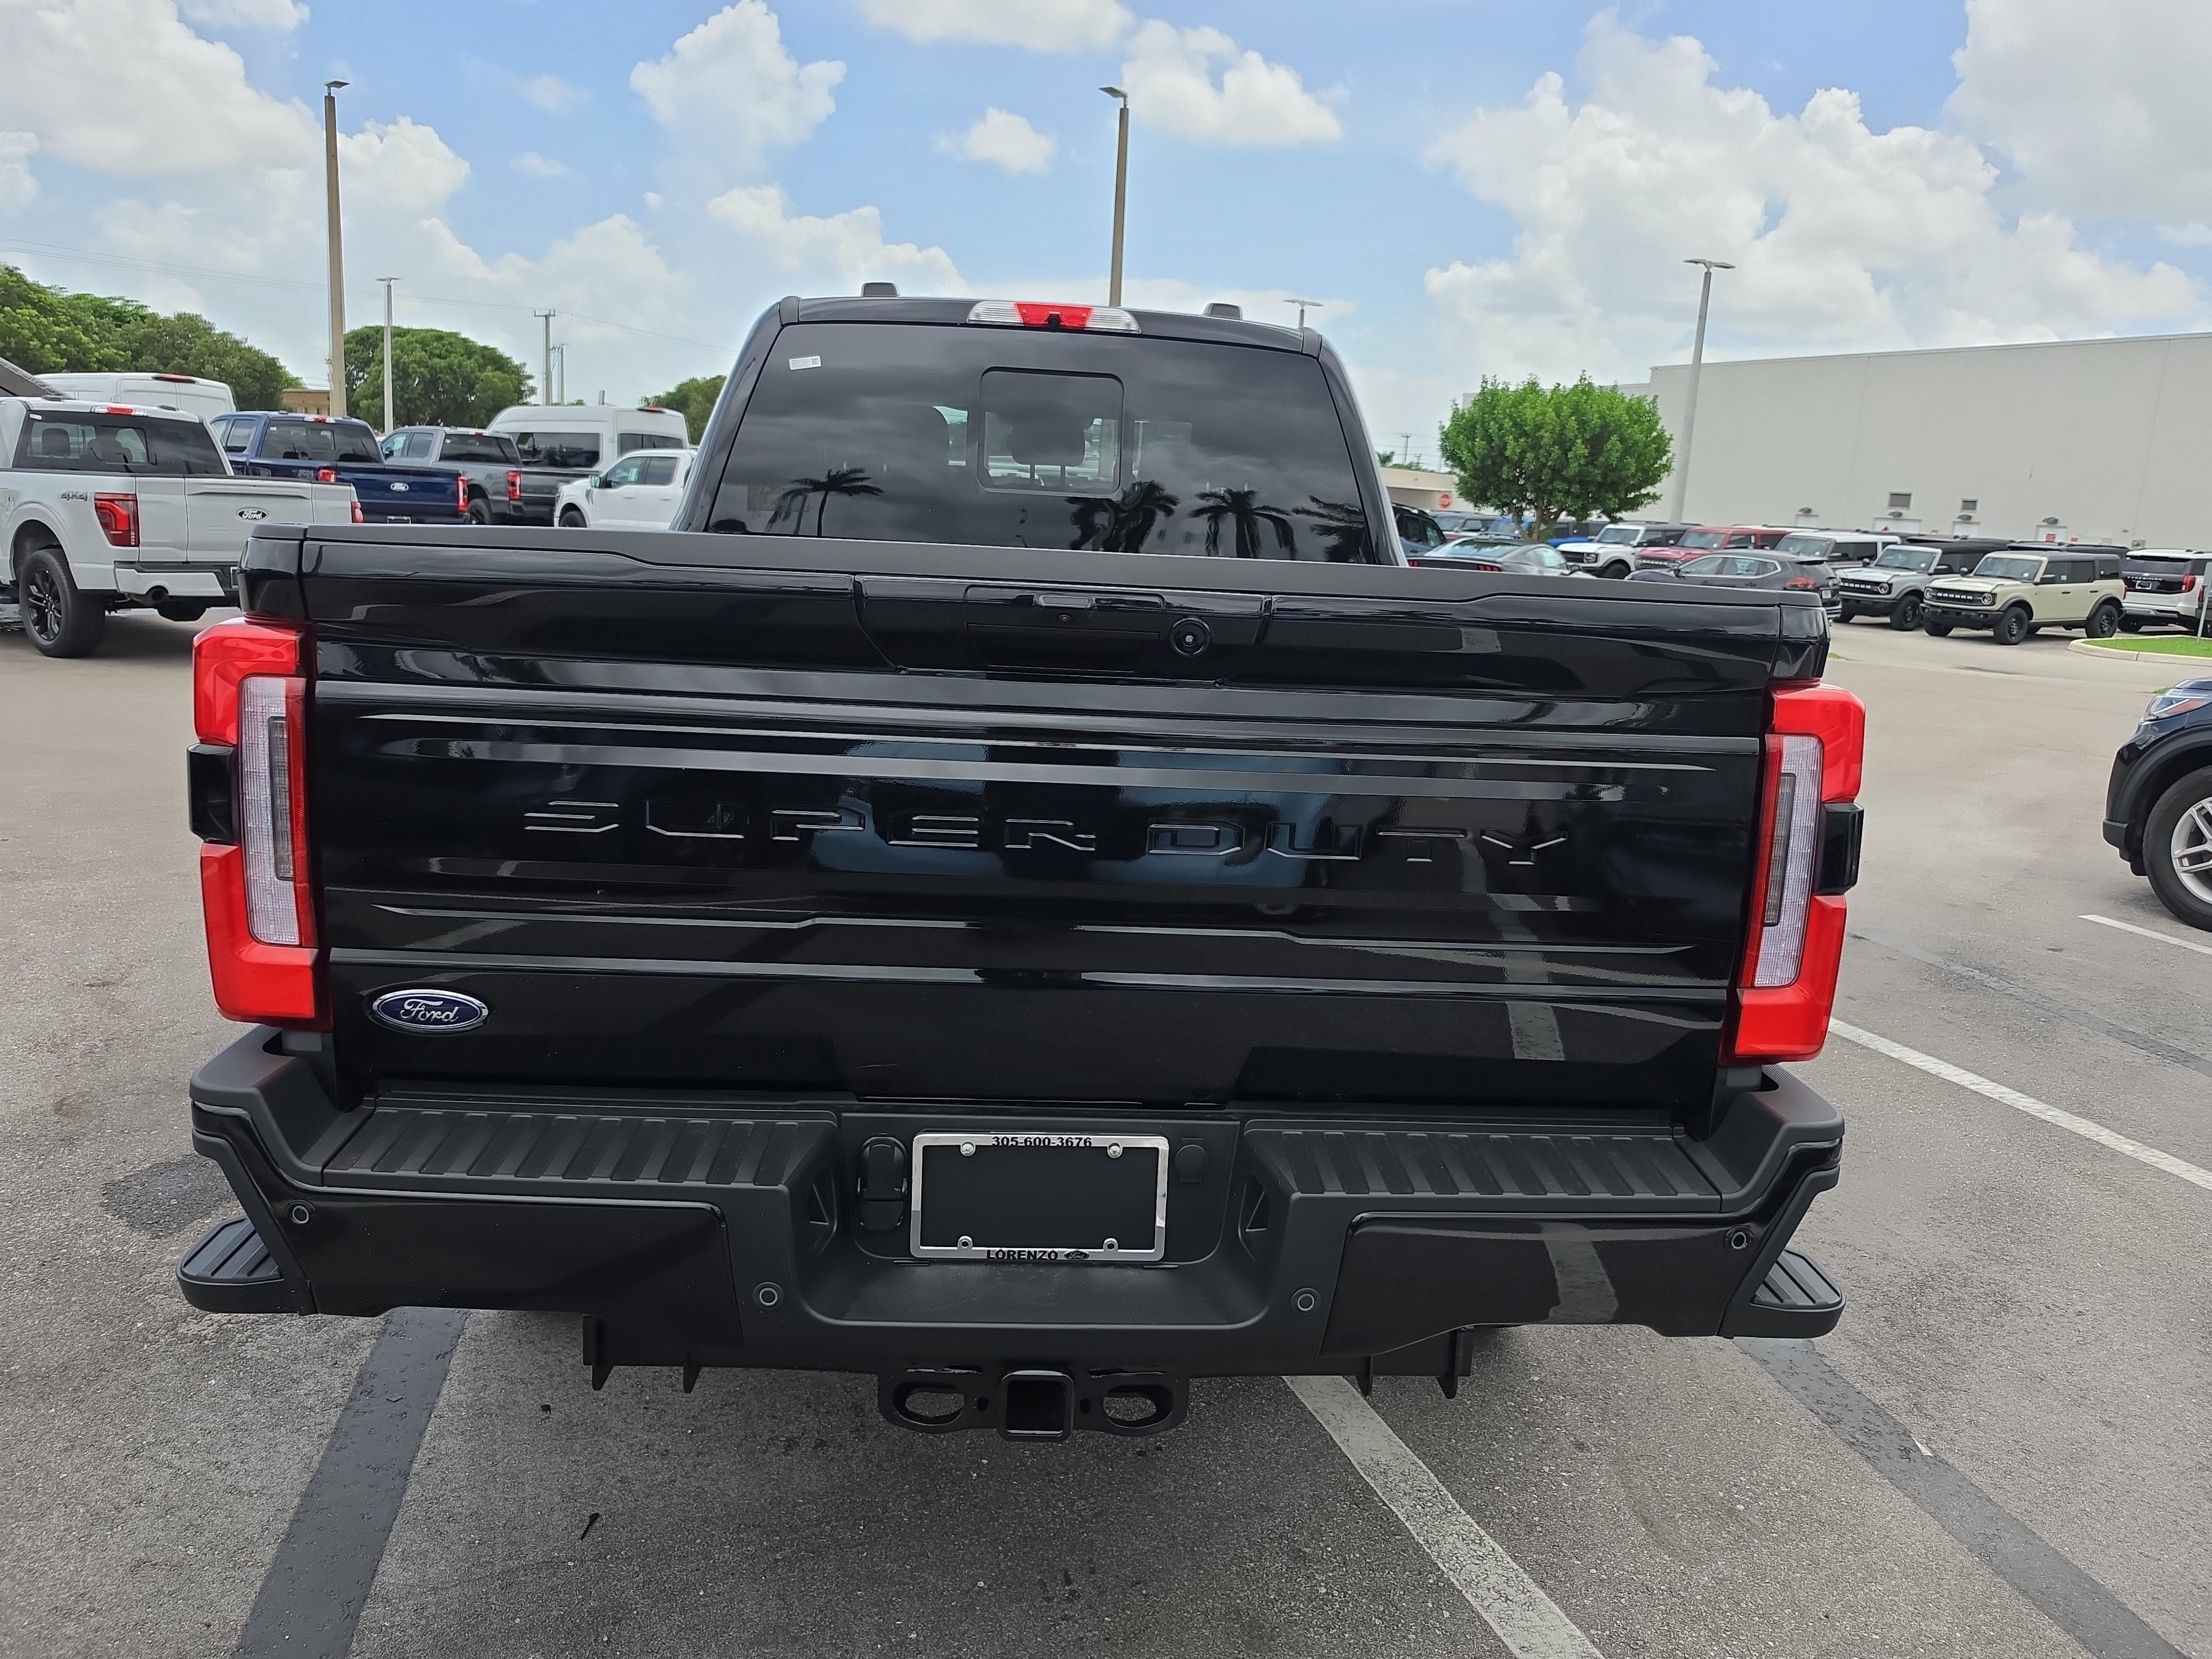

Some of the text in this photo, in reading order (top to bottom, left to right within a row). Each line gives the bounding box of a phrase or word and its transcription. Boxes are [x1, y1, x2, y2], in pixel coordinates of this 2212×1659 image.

[242, 510, 263, 519] Ford
[523, 797, 1568, 866] SUPER DUTY
[398, 998, 460, 1023] Ford
[992, 1136, 1092, 1147] 305-600-3676
[986, 1249, 1058, 1261] LORENZO
